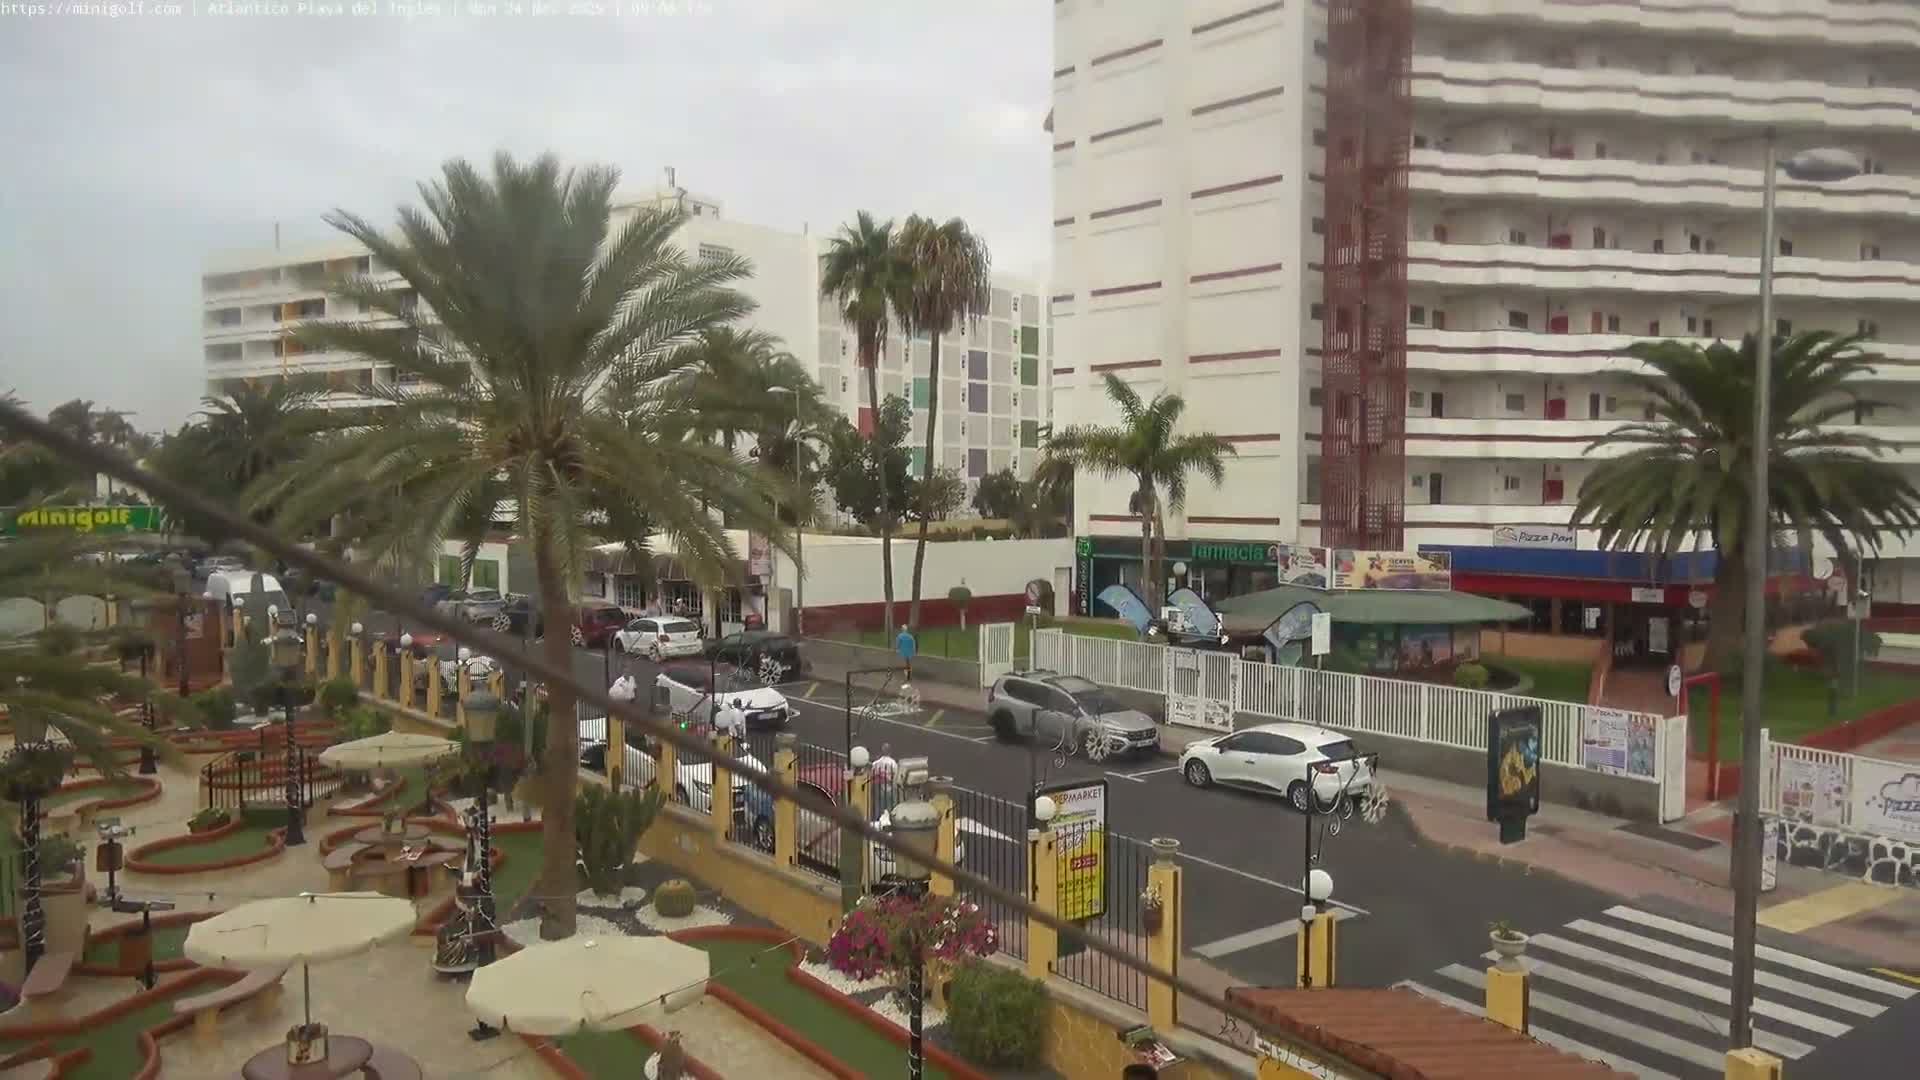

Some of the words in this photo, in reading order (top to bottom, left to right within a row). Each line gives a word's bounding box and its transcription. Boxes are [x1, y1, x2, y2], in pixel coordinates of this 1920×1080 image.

[17, 507, 130, 531] Minigolf
[1518, 532, 1549, 543] Pizza
[1550, 532, 1573, 543] Pan
[1053, 788, 1102, 805] PERMARKET
